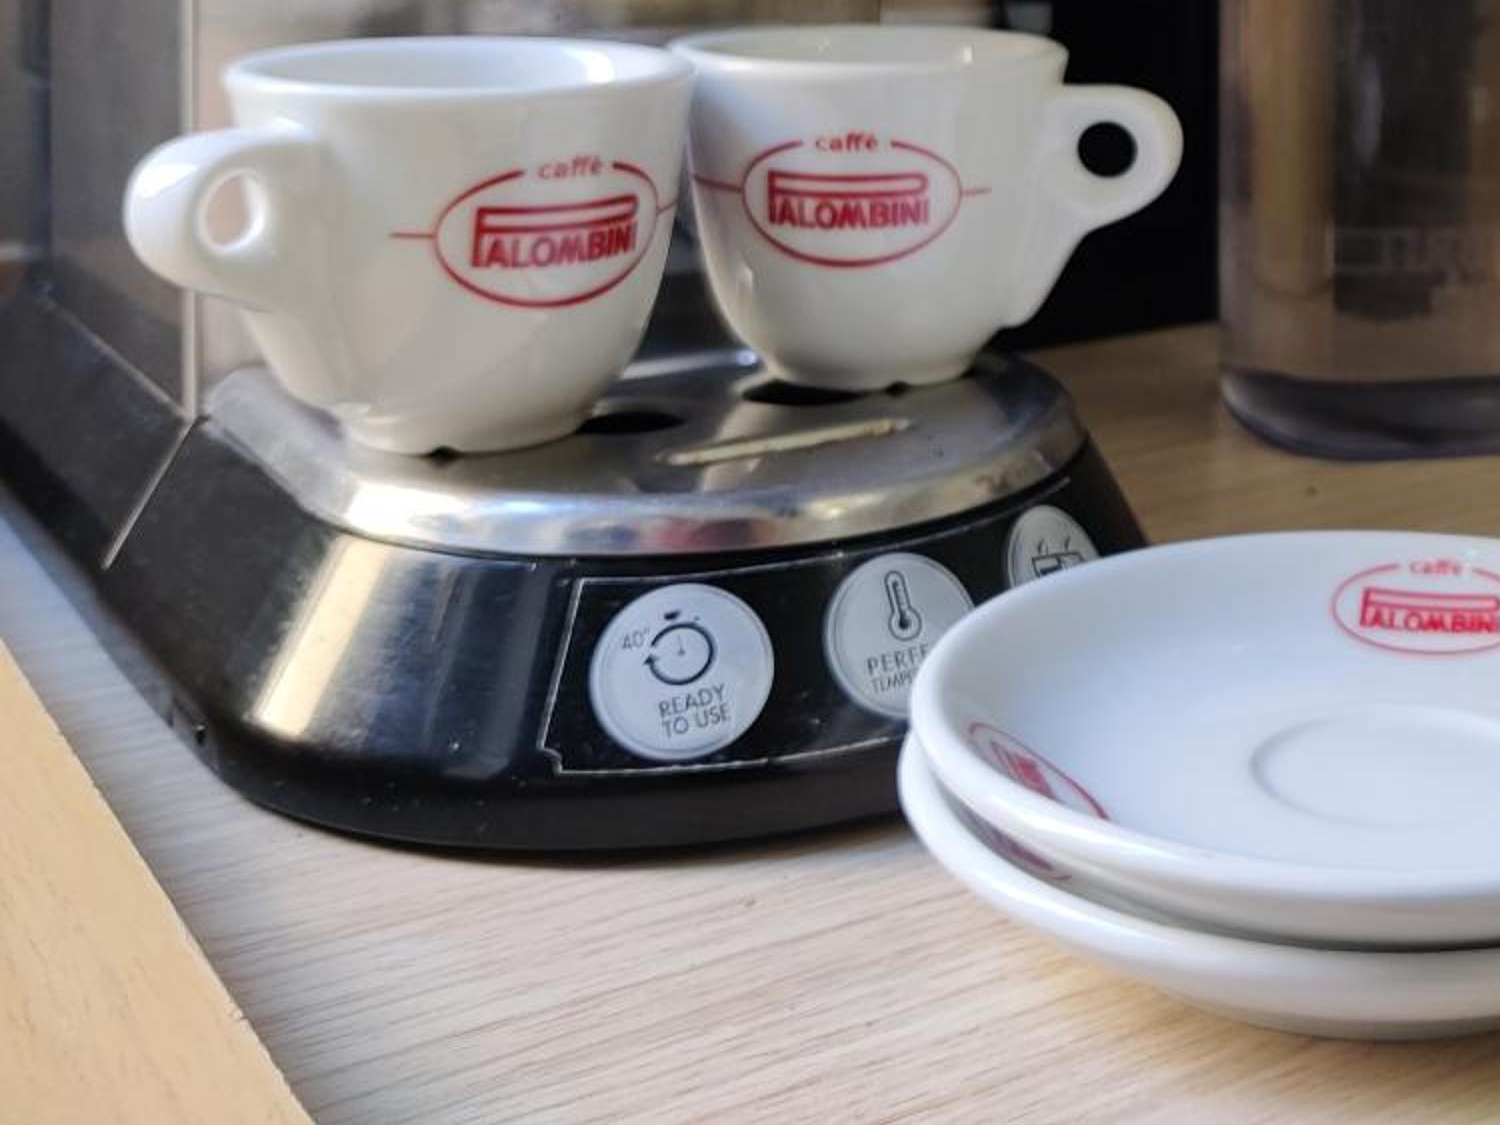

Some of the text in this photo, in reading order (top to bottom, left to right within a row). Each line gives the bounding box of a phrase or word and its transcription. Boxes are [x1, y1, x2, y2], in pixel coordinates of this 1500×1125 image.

[767, 170, 929, 229] PALOMBINI
[658, 683, 726, 719] READY
[661, 702, 731, 739] TO USE
